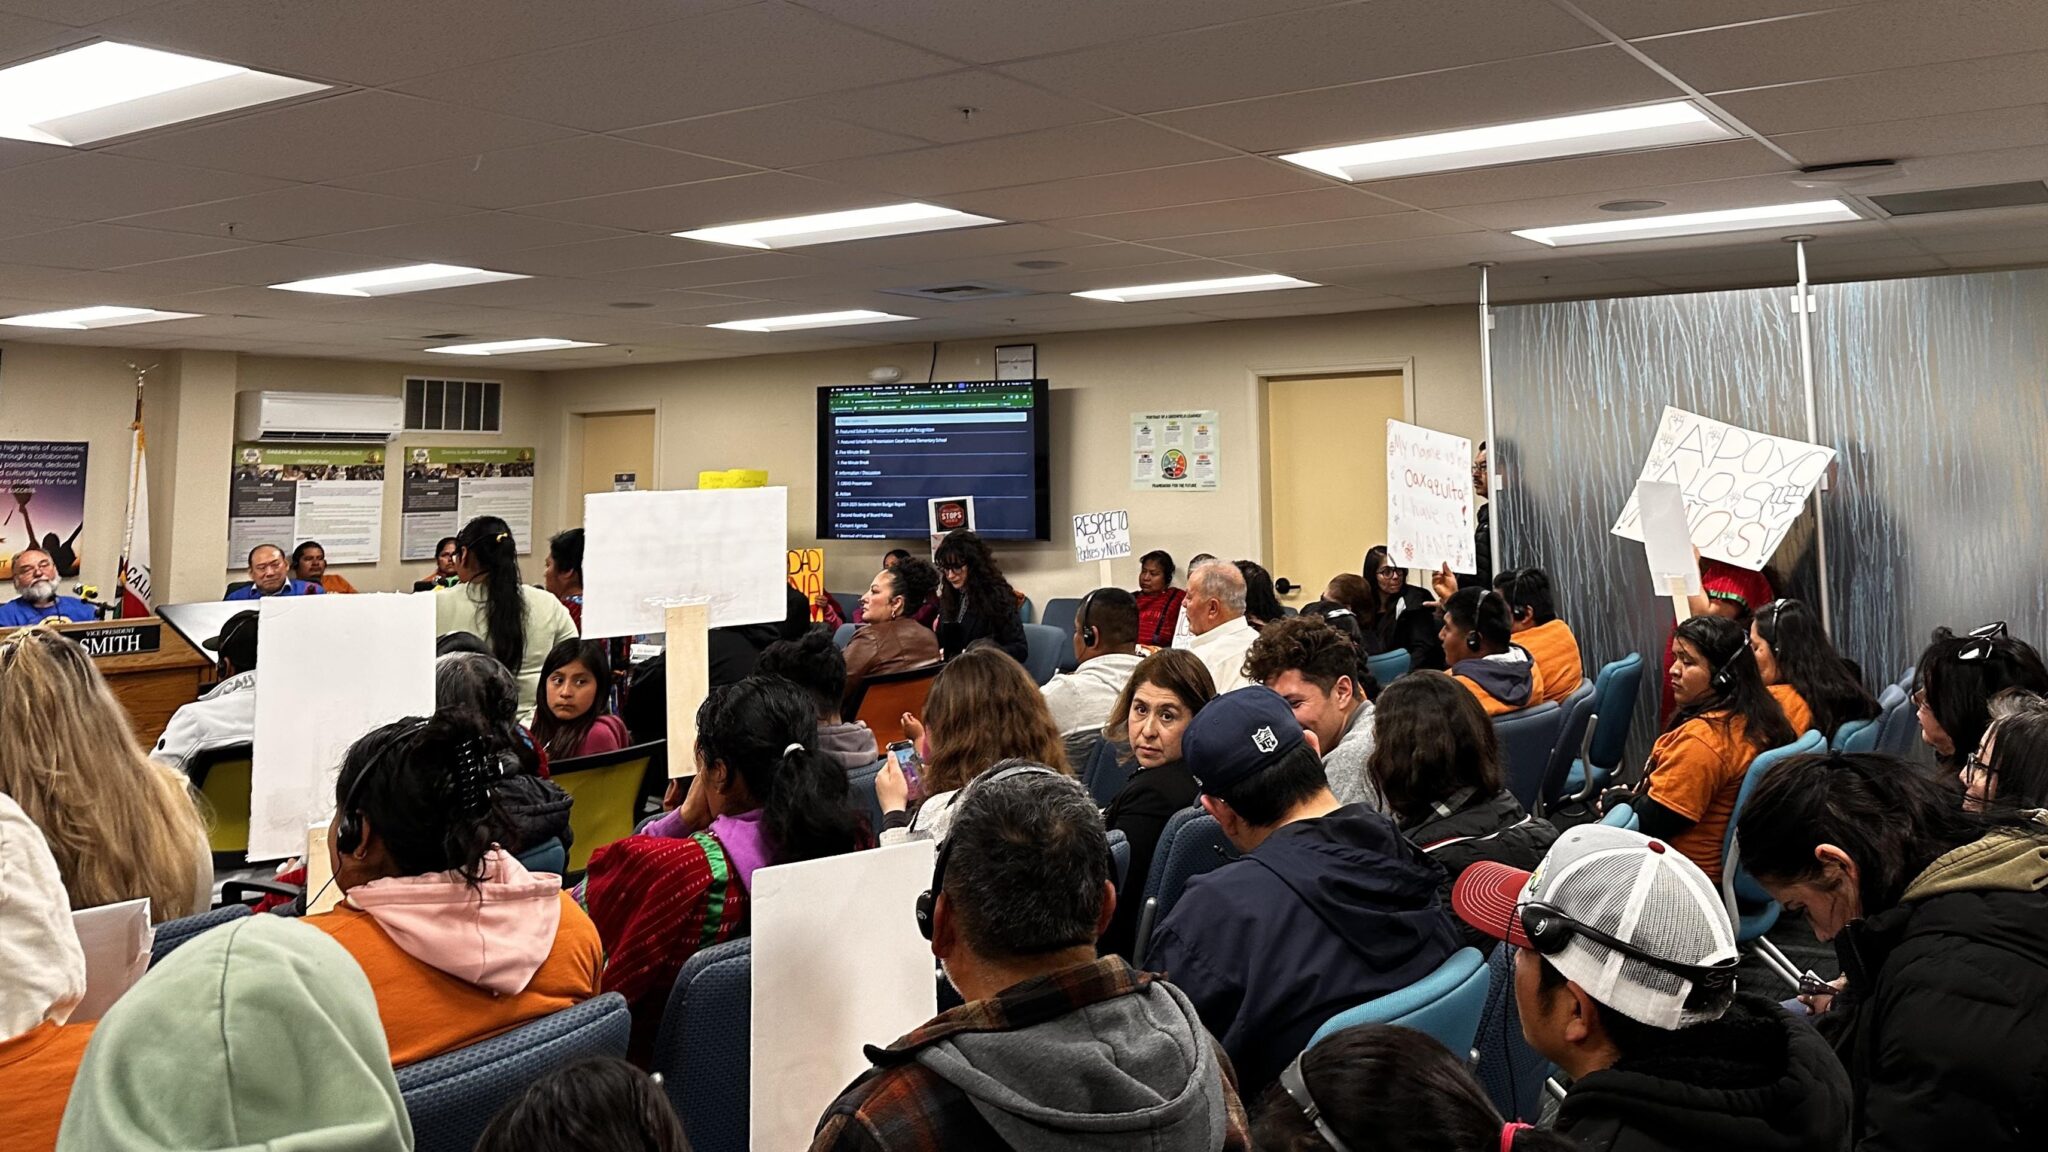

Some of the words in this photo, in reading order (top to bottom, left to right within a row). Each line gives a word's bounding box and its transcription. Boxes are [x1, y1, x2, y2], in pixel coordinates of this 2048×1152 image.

[1668, 424, 1828, 488] APOYO
[941, 512, 962, 520] STOPS
[1075, 510, 1128, 536] RESPECTO
[1102, 532, 1115, 542] los
[101, 627, 135, 636] PRESIDENT
[79, 634, 141, 656] SMITH
